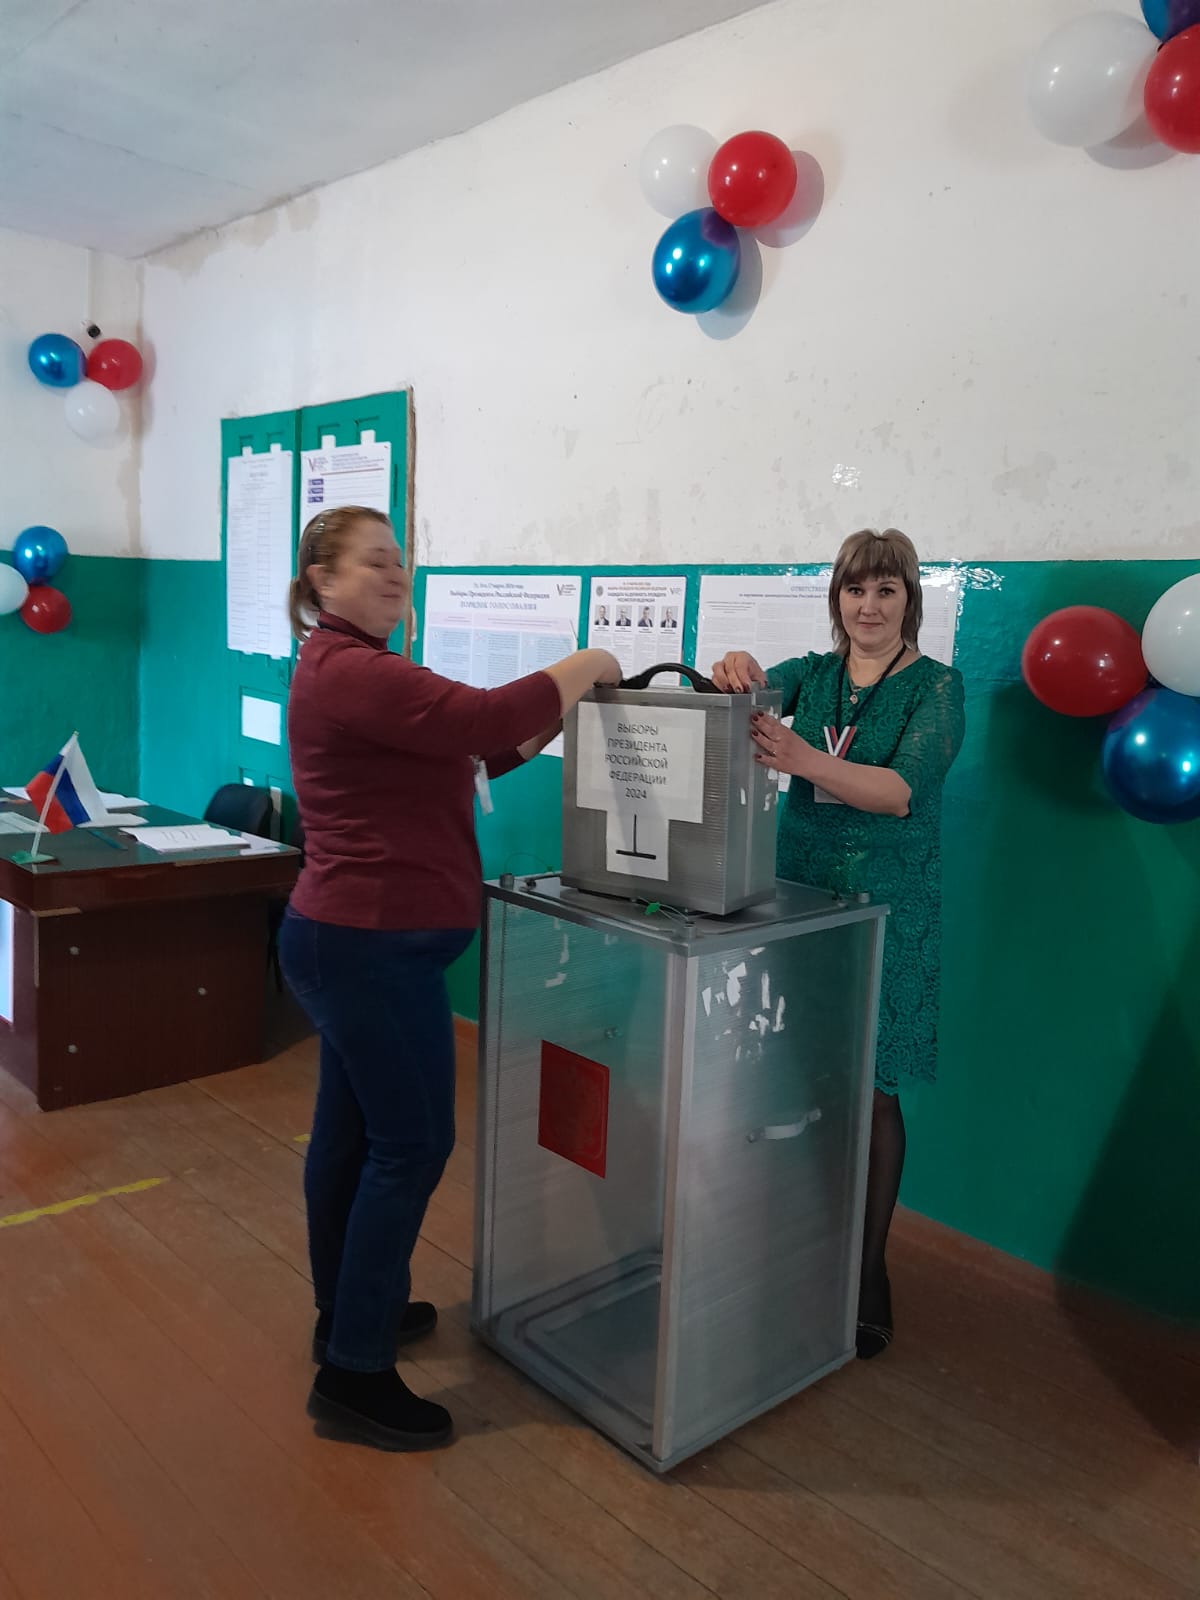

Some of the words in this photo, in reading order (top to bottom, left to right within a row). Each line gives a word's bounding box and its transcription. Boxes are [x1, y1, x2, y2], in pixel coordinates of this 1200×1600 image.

[617, 722, 659, 736] ВЫБОРЫ
[607, 737, 668, 753] ПРЕЗИДЕНТА
[605, 753, 669, 769] РОССИЙСКОЙ
[609, 770, 667, 785] ФЕДЕРАЦИИ
[625, 787, 648, 799] 2024
